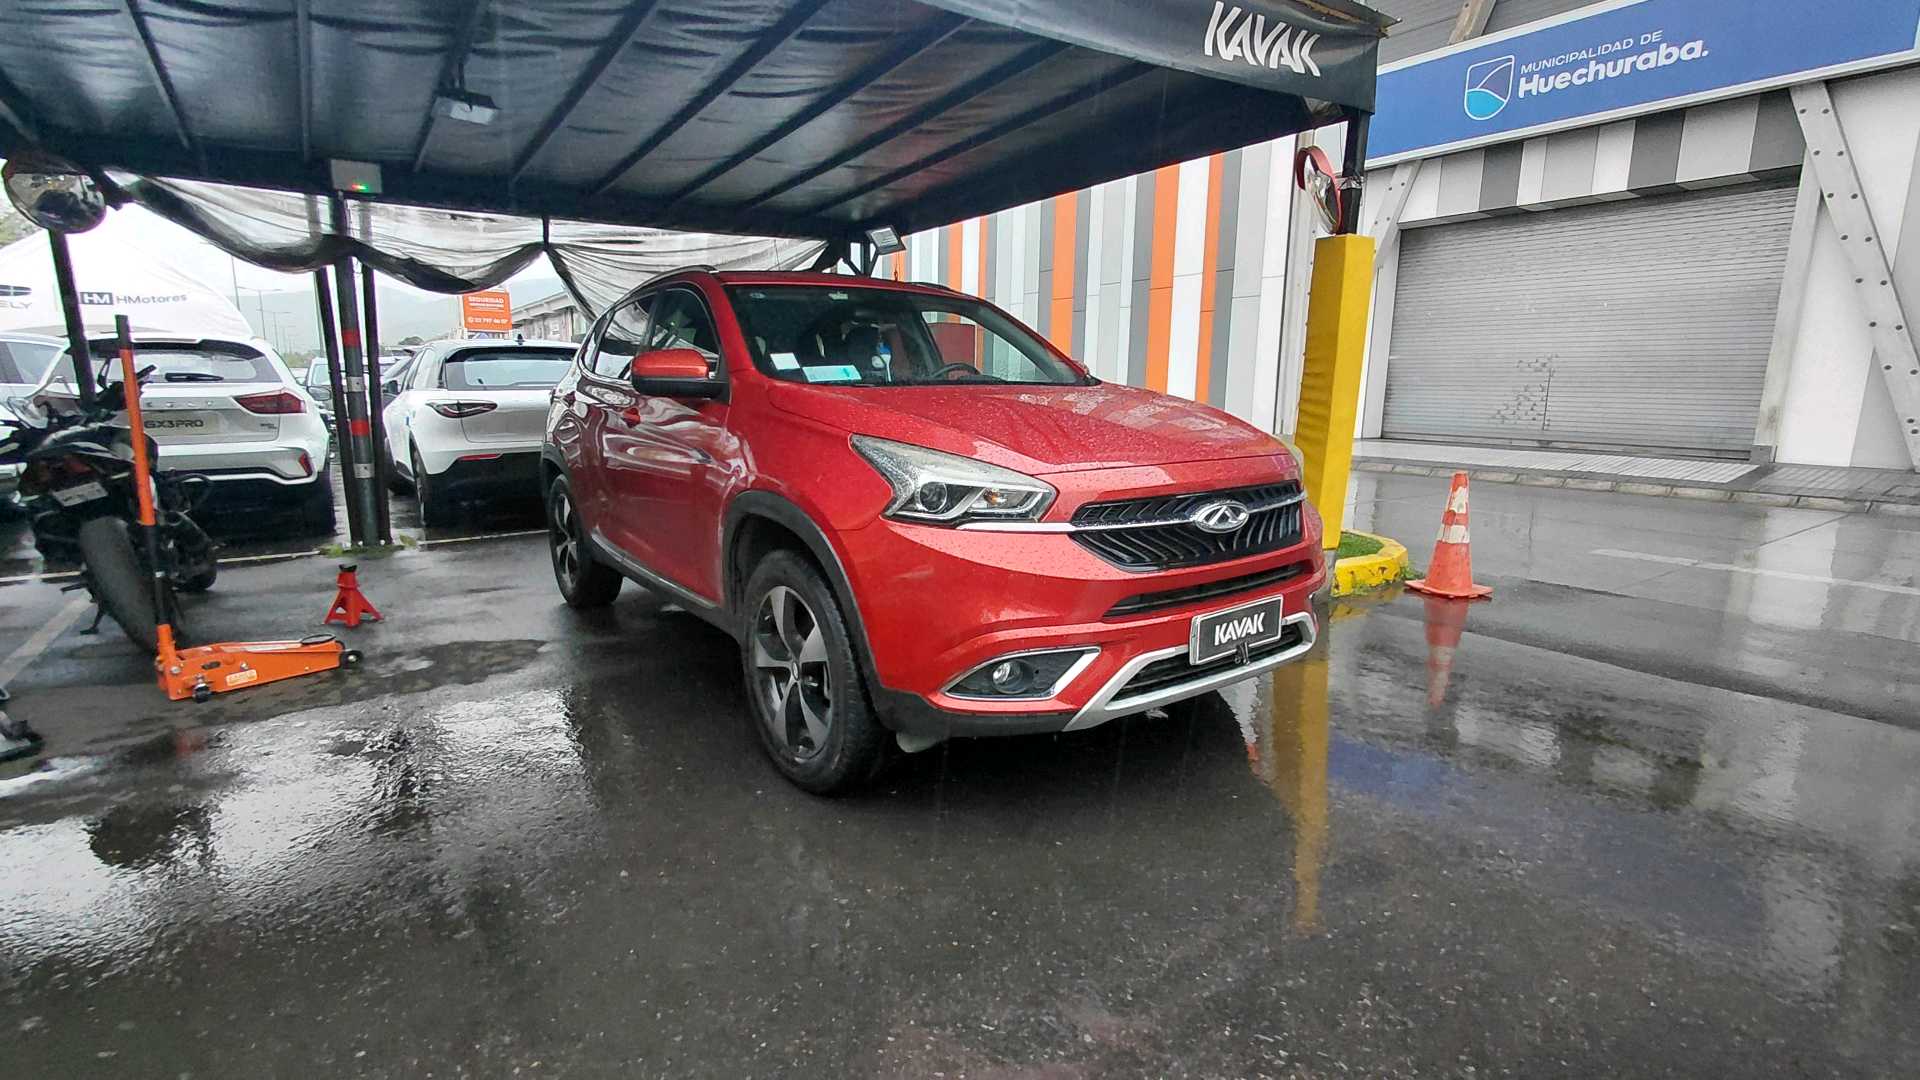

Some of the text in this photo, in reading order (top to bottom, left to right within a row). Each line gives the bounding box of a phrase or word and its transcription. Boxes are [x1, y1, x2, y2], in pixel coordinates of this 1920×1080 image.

[1204, 1, 1321, 77] KAVAK
[1520, 30, 1663, 75] MUNICIPALIDAD DE
[1518, 40, 1709, 99] Huechuraba.
[82, 292, 188, 305] HM HMotores
[1214, 612, 1266, 646] KAVAK
